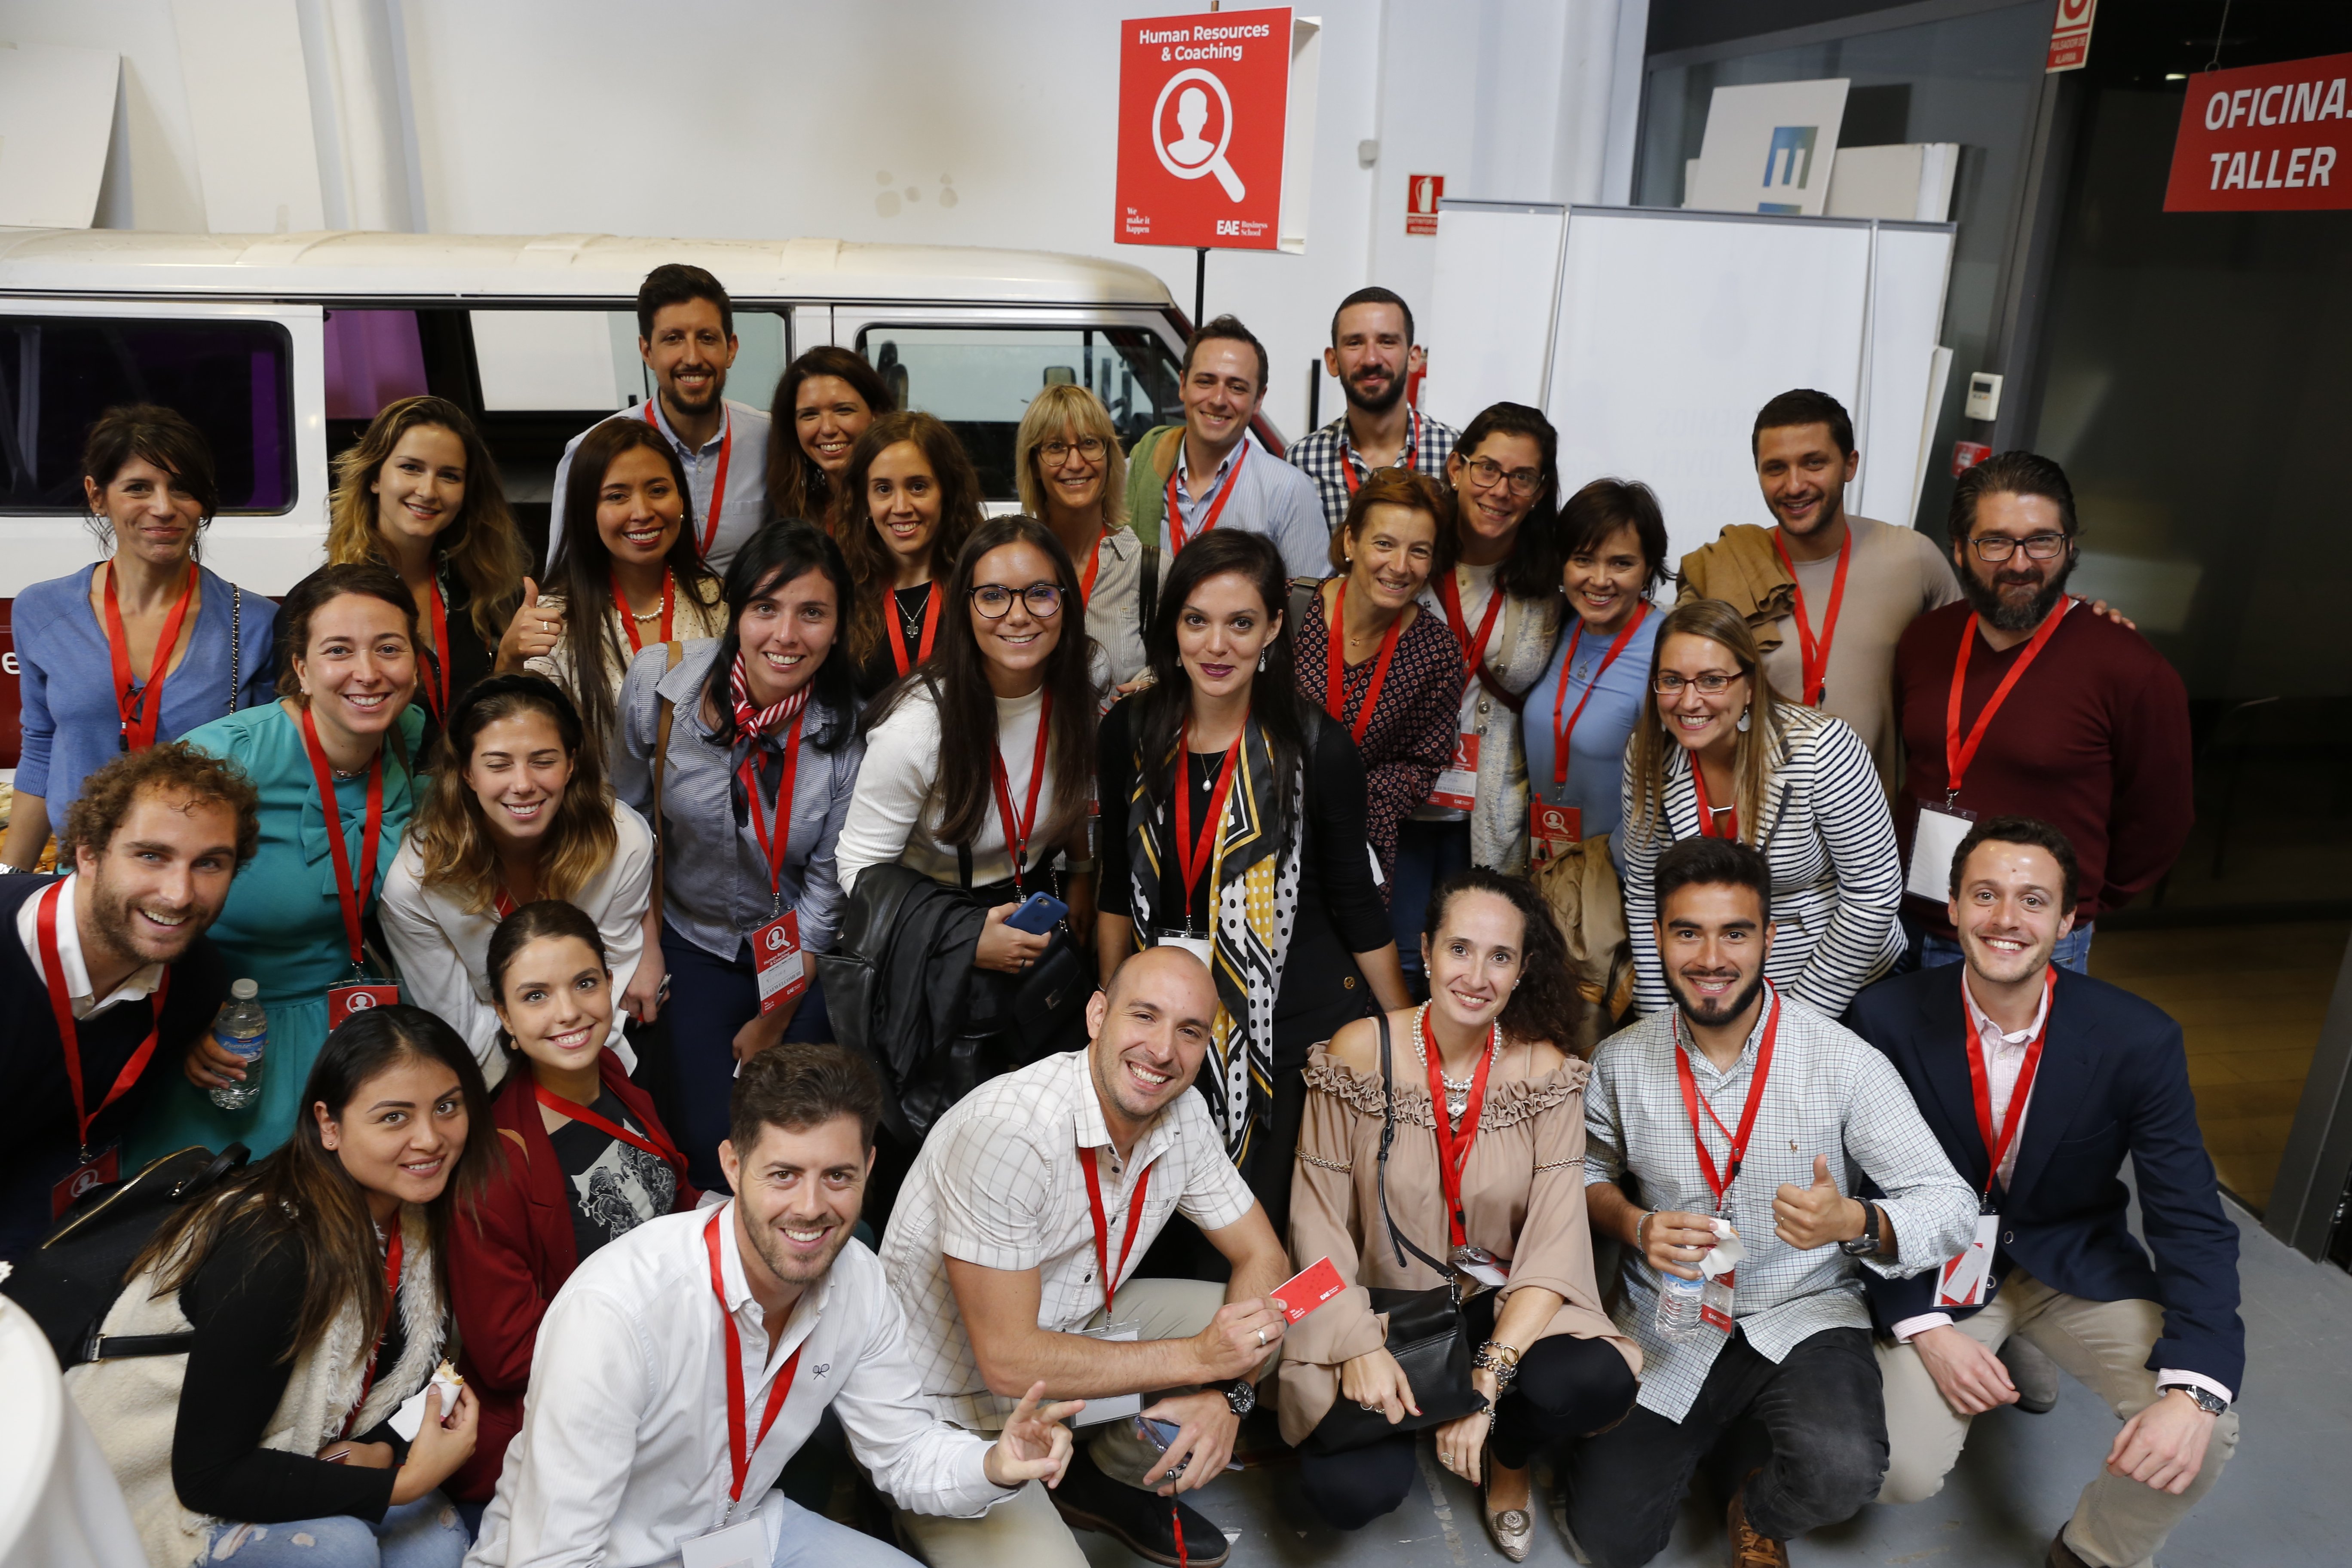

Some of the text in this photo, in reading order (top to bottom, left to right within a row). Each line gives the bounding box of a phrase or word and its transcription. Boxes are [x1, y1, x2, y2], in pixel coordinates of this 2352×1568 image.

[1139, 24, 1269, 44] Human Resources
[1161, 42, 1242, 61] & Coaching
[2205, 78, 2352, 131] OFICINA
[2210, 146, 2337, 190] TALLER
[1127, 207, 1137, 215] We
[1127, 215, 1150, 224] make it
[1126, 224, 1149, 234] happen
[1217, 220, 1239, 235] EAE
[1320, 1291, 1331, 1301] EAE
